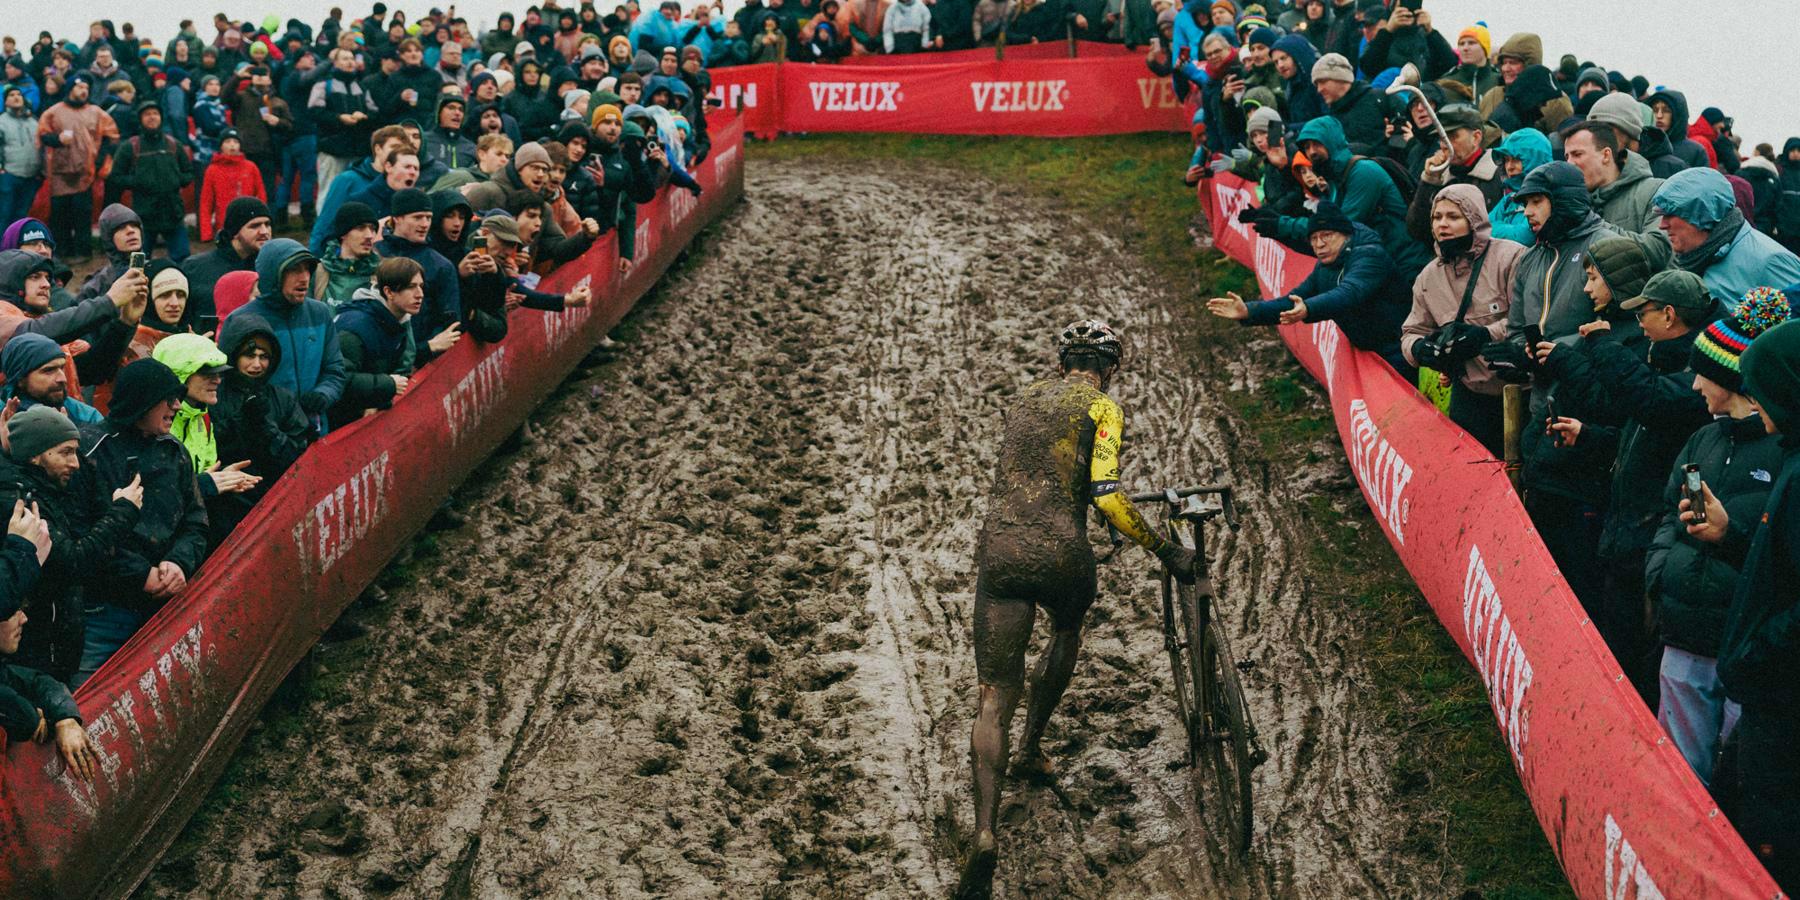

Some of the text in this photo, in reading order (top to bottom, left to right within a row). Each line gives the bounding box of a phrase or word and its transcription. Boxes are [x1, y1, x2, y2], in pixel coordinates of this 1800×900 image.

[809, 81, 900, 111] VELUX
[970, 79, 1066, 112] VELUX
[1350, 399, 1413, 544] VELUX
[1463, 543, 1534, 772] VELUX
